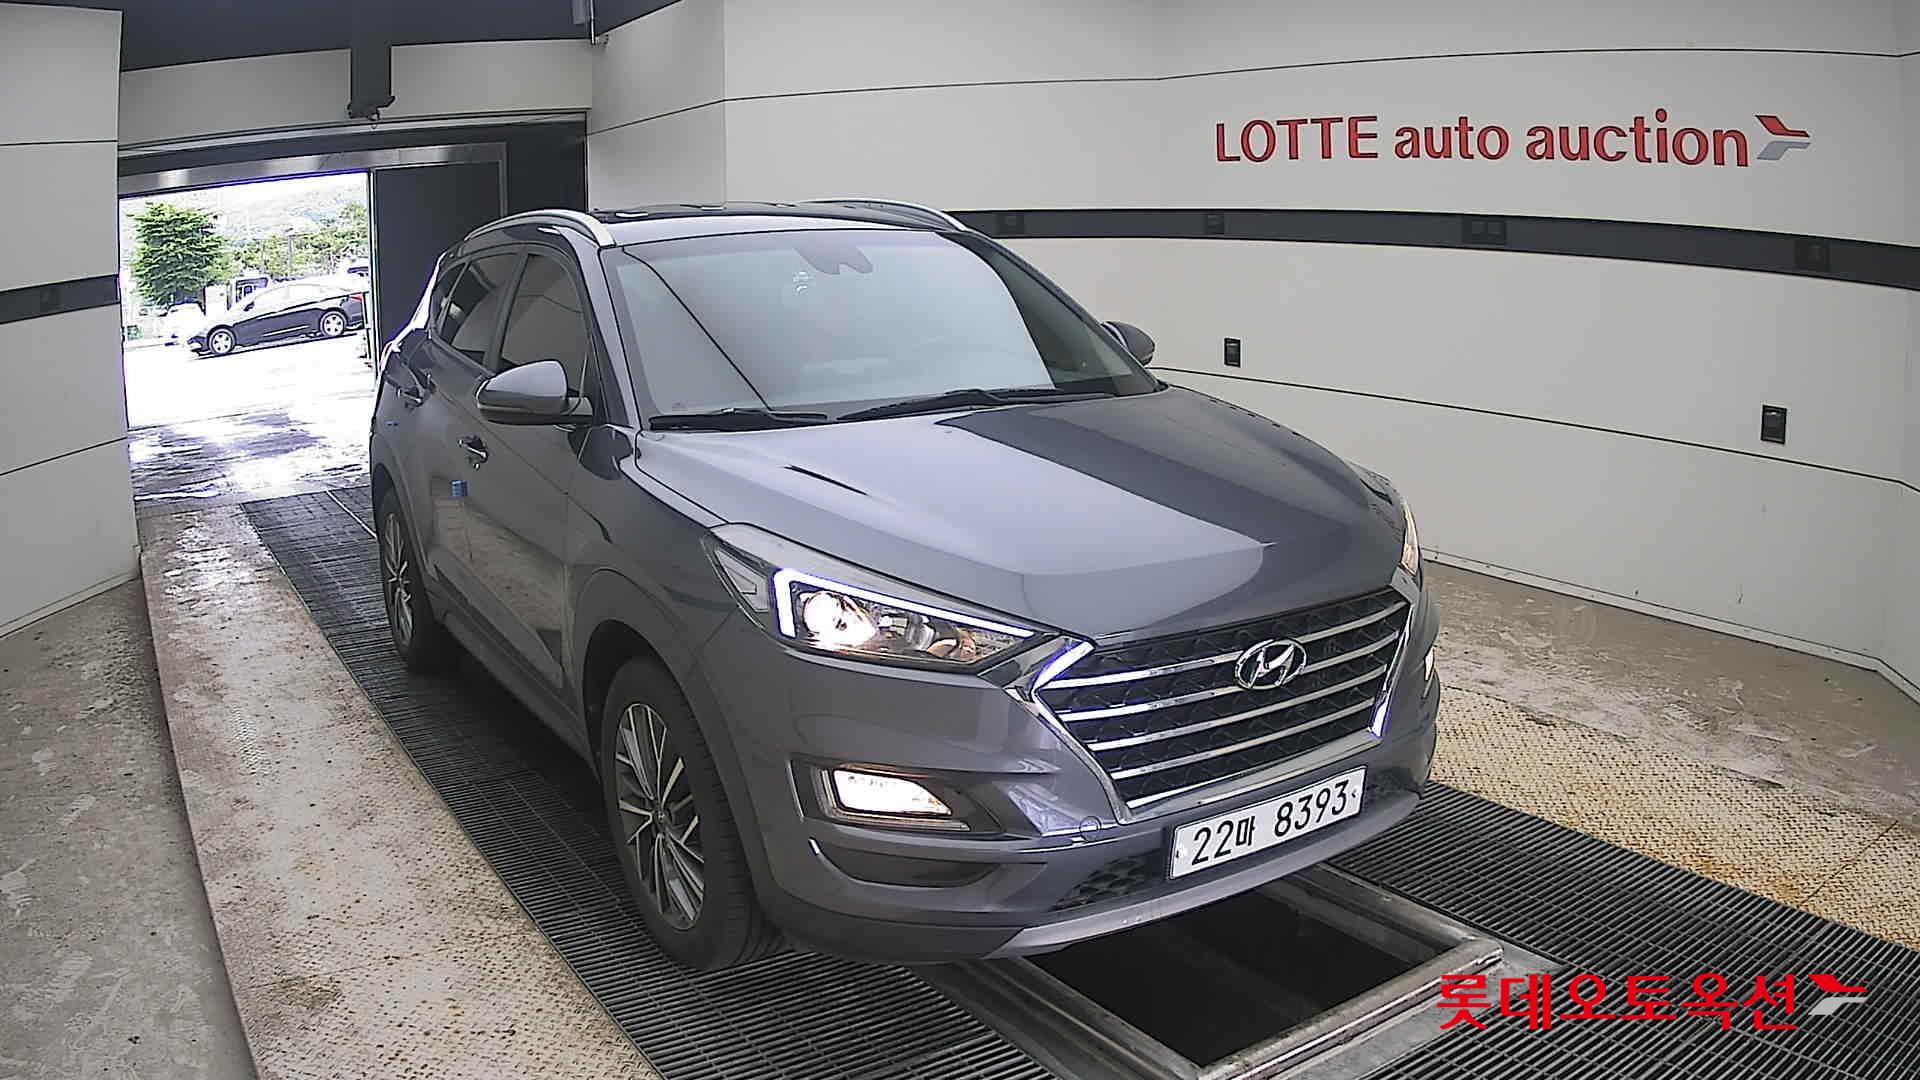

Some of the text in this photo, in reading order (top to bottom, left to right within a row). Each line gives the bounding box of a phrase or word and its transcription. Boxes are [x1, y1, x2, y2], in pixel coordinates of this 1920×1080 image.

[1215, 107, 1750, 168] LOTTE auto auction
[1191, 779, 1350, 866] 22마 8393
